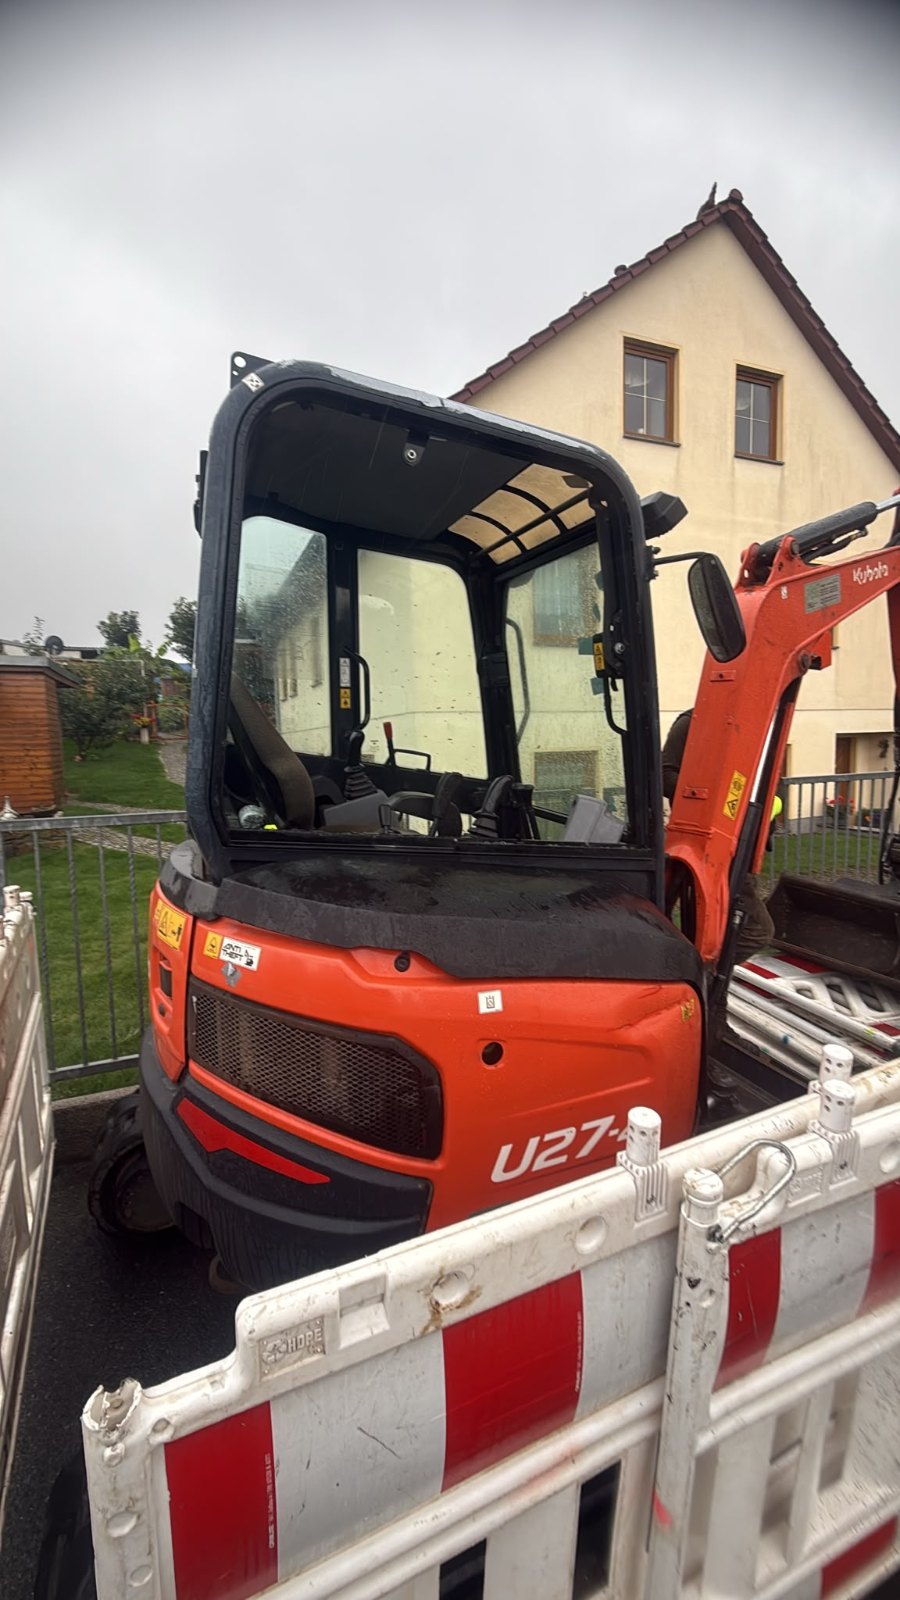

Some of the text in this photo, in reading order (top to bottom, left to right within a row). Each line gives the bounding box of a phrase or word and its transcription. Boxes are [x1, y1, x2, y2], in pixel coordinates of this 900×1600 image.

[852, 561, 889, 585] Kubota
[222, 948, 244, 961] THEFT
[223, 943, 242, 953] ANTI
